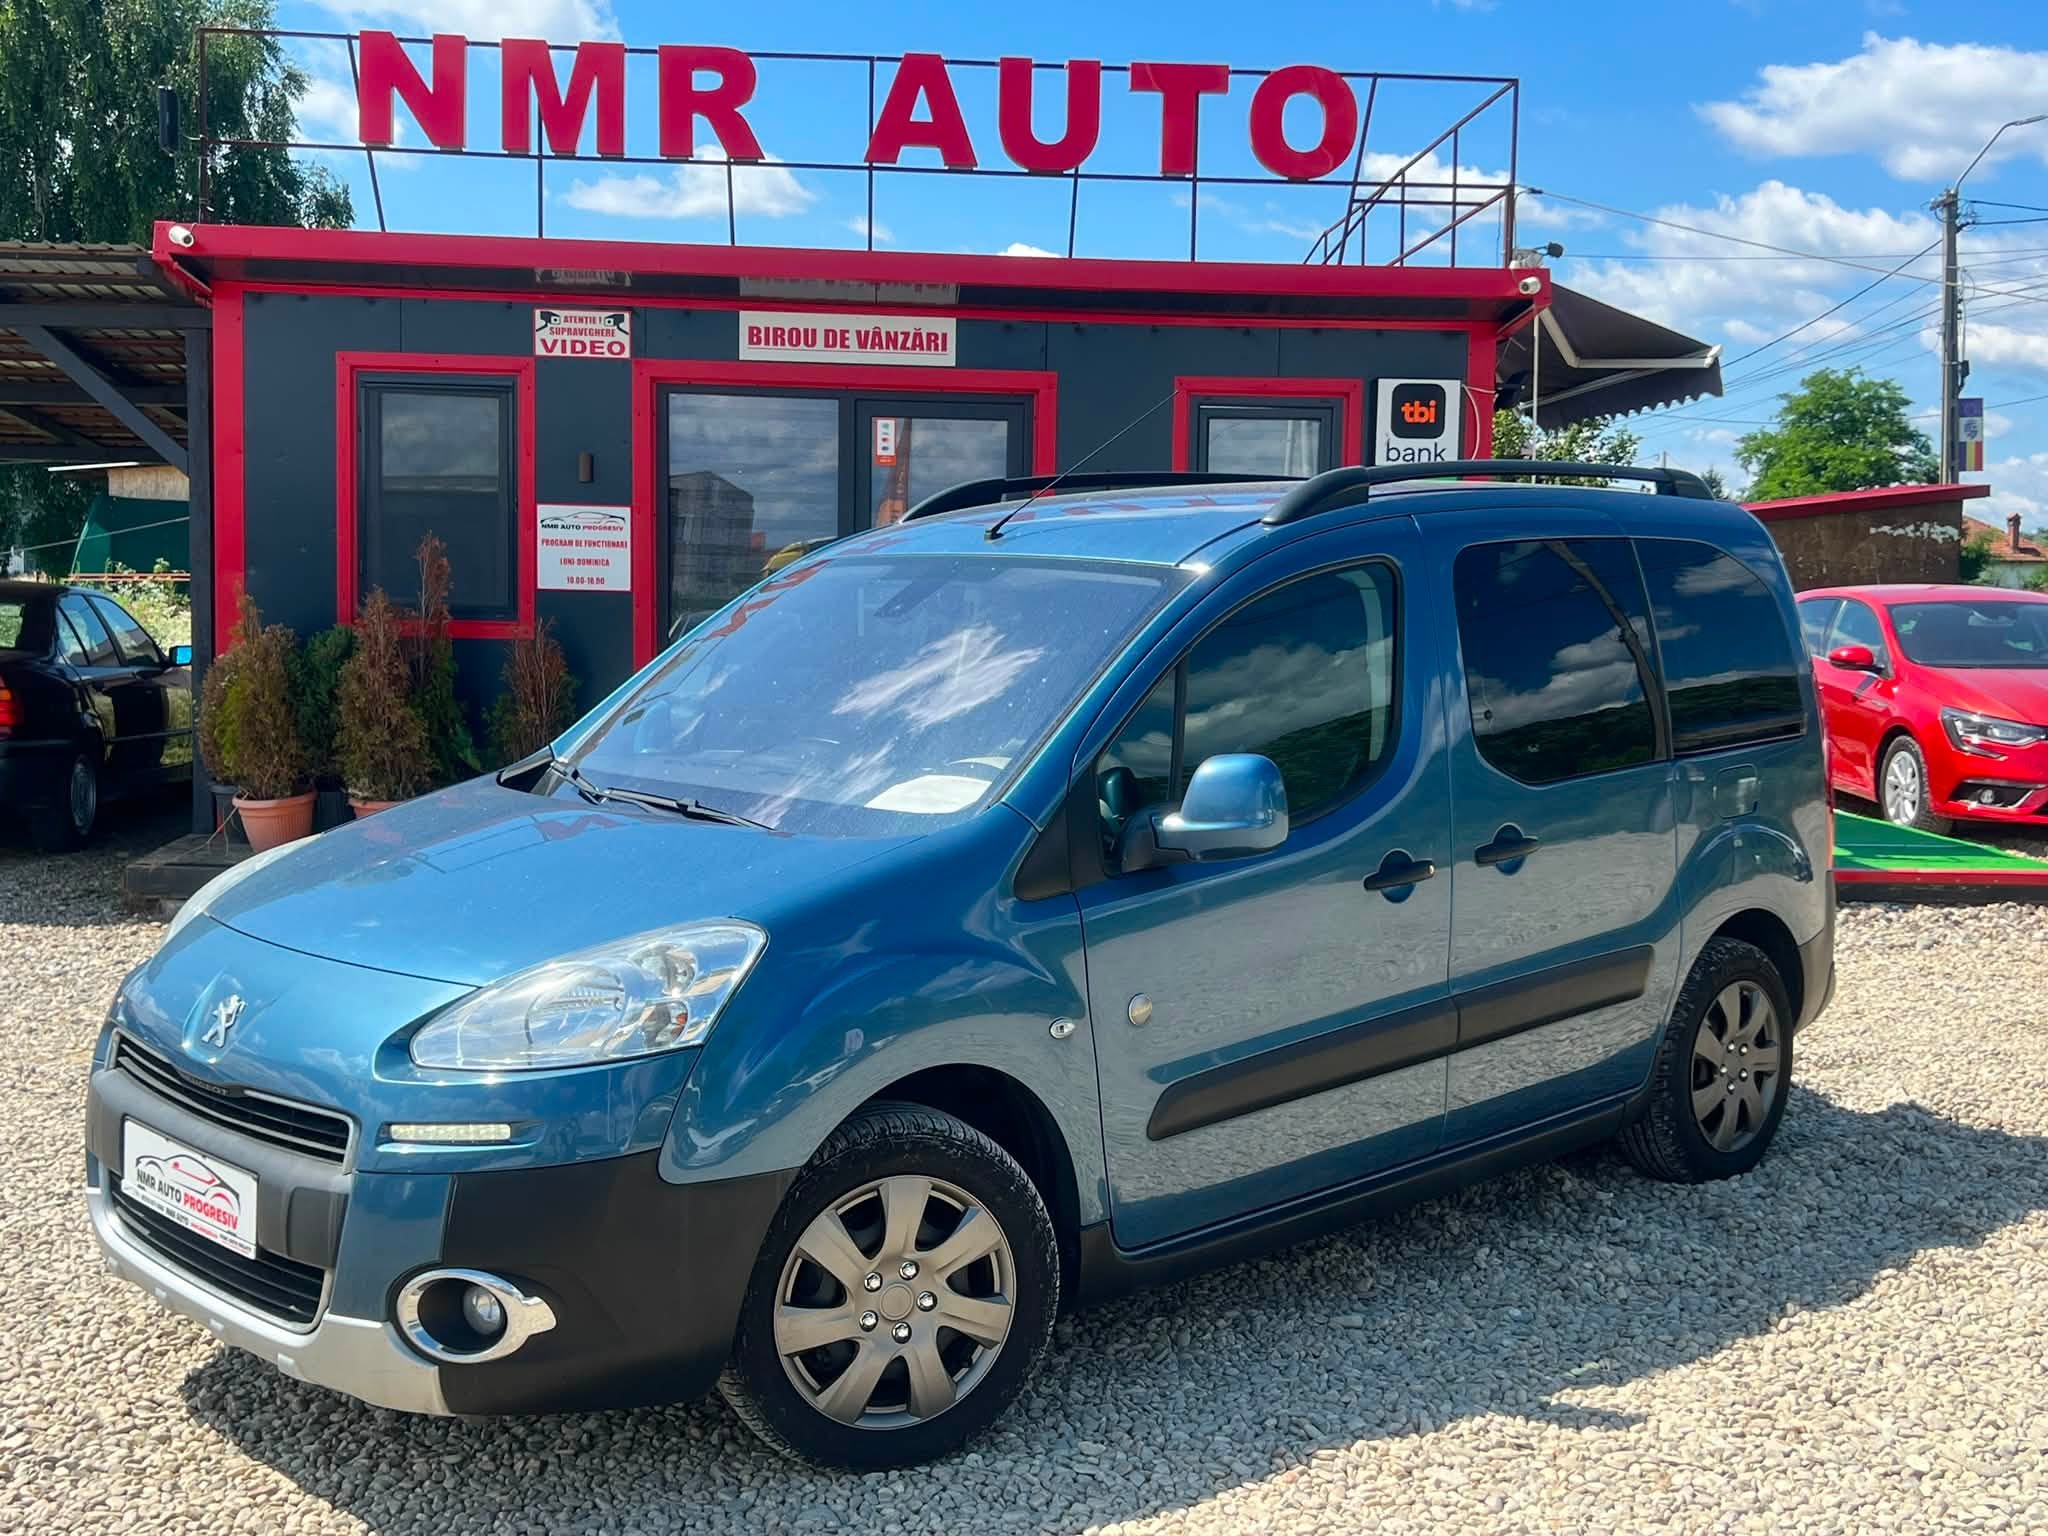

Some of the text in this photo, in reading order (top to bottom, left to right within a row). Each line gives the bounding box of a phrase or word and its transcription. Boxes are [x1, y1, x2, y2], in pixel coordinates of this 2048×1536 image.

[359, 30, 1358, 180] NMR AUTO
[549, 326, 616, 337] SUPRAVEGHERE
[747, 325, 948, 353] BIROU DE VÂNZĂRI
[541, 338, 626, 355] VIDEO
[1401, 400, 1437, 423] tbi
[1386, 439, 1447, 462] bank
[541, 538, 574, 547] PROGRAM
[136, 1168, 157, 1191] NMR
[157, 1180, 183, 1203] AUTO
[183, 1192, 238, 1230] PROGRESIV
